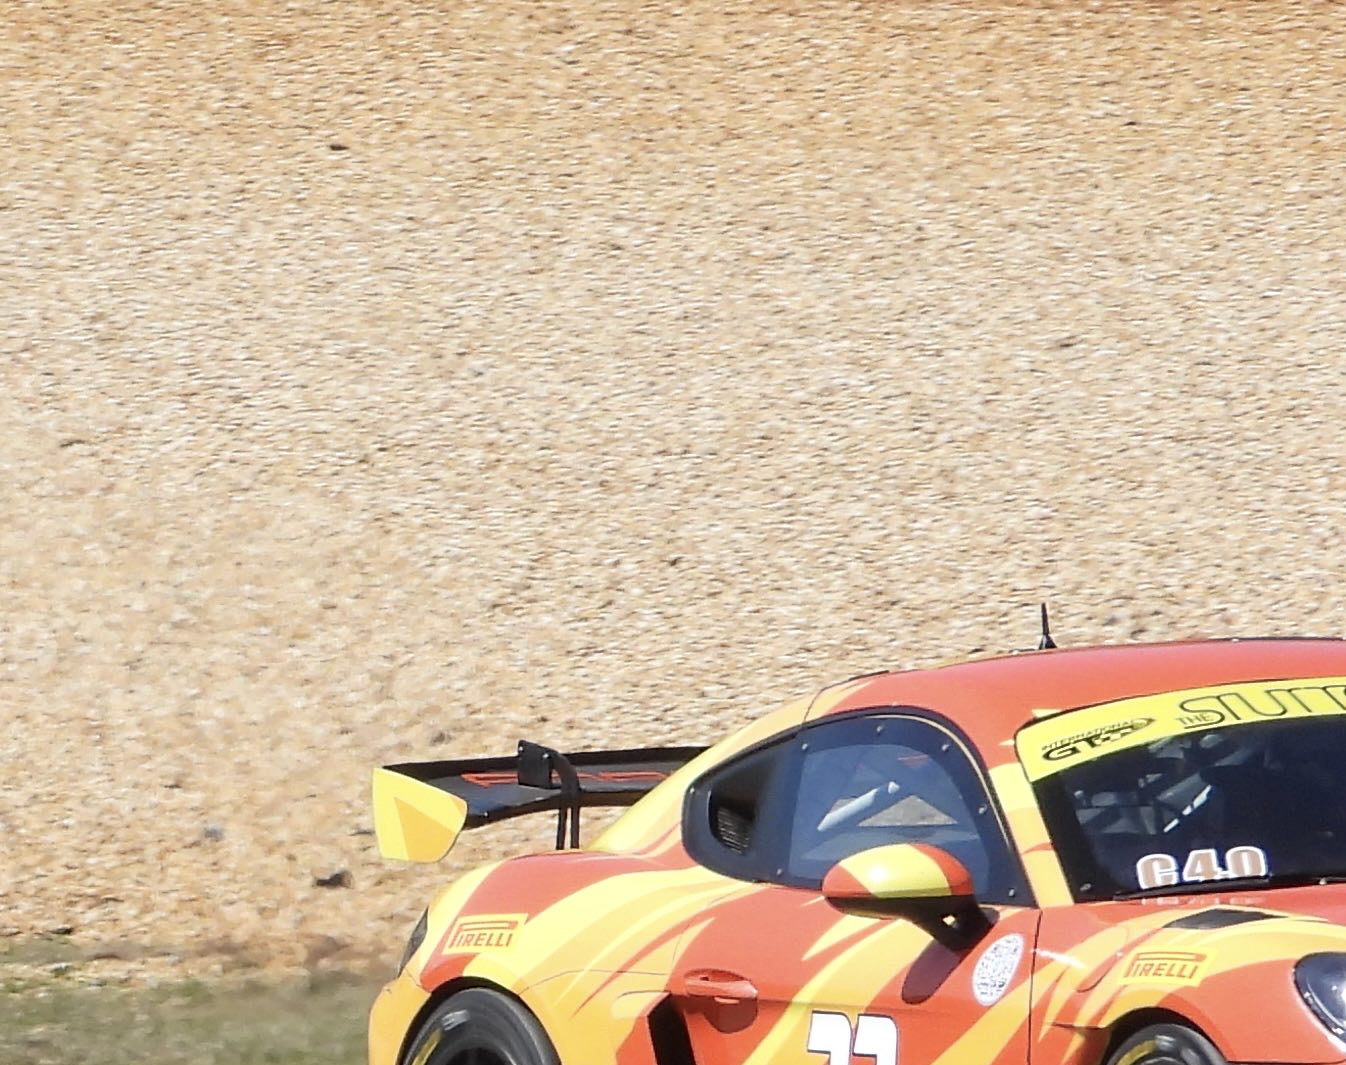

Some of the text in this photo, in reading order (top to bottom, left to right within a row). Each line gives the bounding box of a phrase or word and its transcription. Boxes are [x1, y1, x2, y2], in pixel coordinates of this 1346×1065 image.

[1175, 712, 1215, 726] THE
[448, 920, 518, 949] PIRELLI
[1123, 951, 1207, 979] PIRELLI
